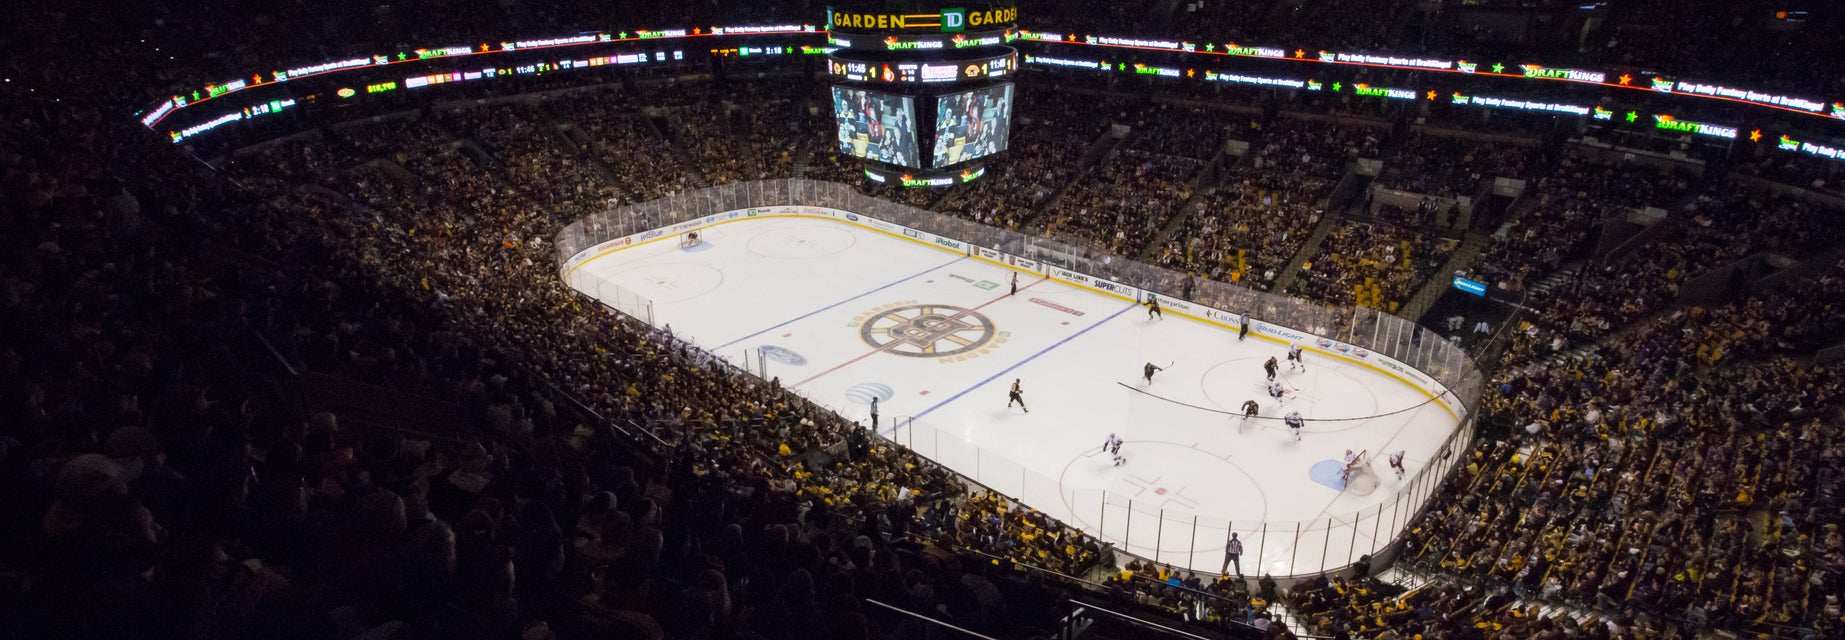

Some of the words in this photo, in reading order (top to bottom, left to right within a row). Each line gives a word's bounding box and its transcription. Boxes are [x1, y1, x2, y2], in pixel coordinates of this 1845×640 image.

[834, 12, 905, 28] GARDEN
[944, 12, 963, 28] TD
[1022, 32, 1062, 40] DRAFTKINGS
[888, 40, 943, 50] DRAFTKINGS
[955, 37, 1000, 48] DRAFTKINGS
[420, 46, 472, 60] DRAFTKINGS
[765, 46, 782, 54] 2:18
[1228, 47, 1285, 57] DRAFTKINGS
[1006, 59, 1011, 70] 1
[1338, 53, 1351, 62] Play
[1365, 55, 1389, 65] Fantasy
[1388, 56, 1409, 66] Sports
[516, 65, 535, 74] 11:45
[841, 64, 847, 75] 1
[847, 62, 866, 73] 11:45
[869, 66, 877, 78] 1
[981, 63, 988, 74] 1
[1136, 66, 1180, 77] DRAFTKINGS
[1525, 69, 1605, 82] DRAFTKINGS
[1356, 87, 1416, 99] DRAFTKINGS
[1677, 81, 1696, 93] Play
[1695, 83, 1717, 96] Daily
[1716, 86, 1747, 99] Fantasy
[1746, 90, 1772, 103] Sports
[1770, 95, 1781, 104] at
[1780, 96, 1824, 112] DraftKings!
[252, 103, 269, 115] 2:18
[1472, 96, 1486, 105] Play
[1485, 97, 1501, 107] Daily
[1501, 98, 1525, 109] Fantasy
[1525, 101, 1546, 110] Sports
[1656, 120, 1738, 138] DRAFTKINGS
[1802, 142, 1819, 155] Play
[1817, 145, 1837, 158] Daily
[904, 177, 953, 187] DRAFTKINGS
[935, 236, 960, 250] iRobot
[1094, 279, 1133, 296] SUPERCUTS
[1259, 324, 1277, 334] BUD
[1276, 330, 1304, 341] LIGHT
